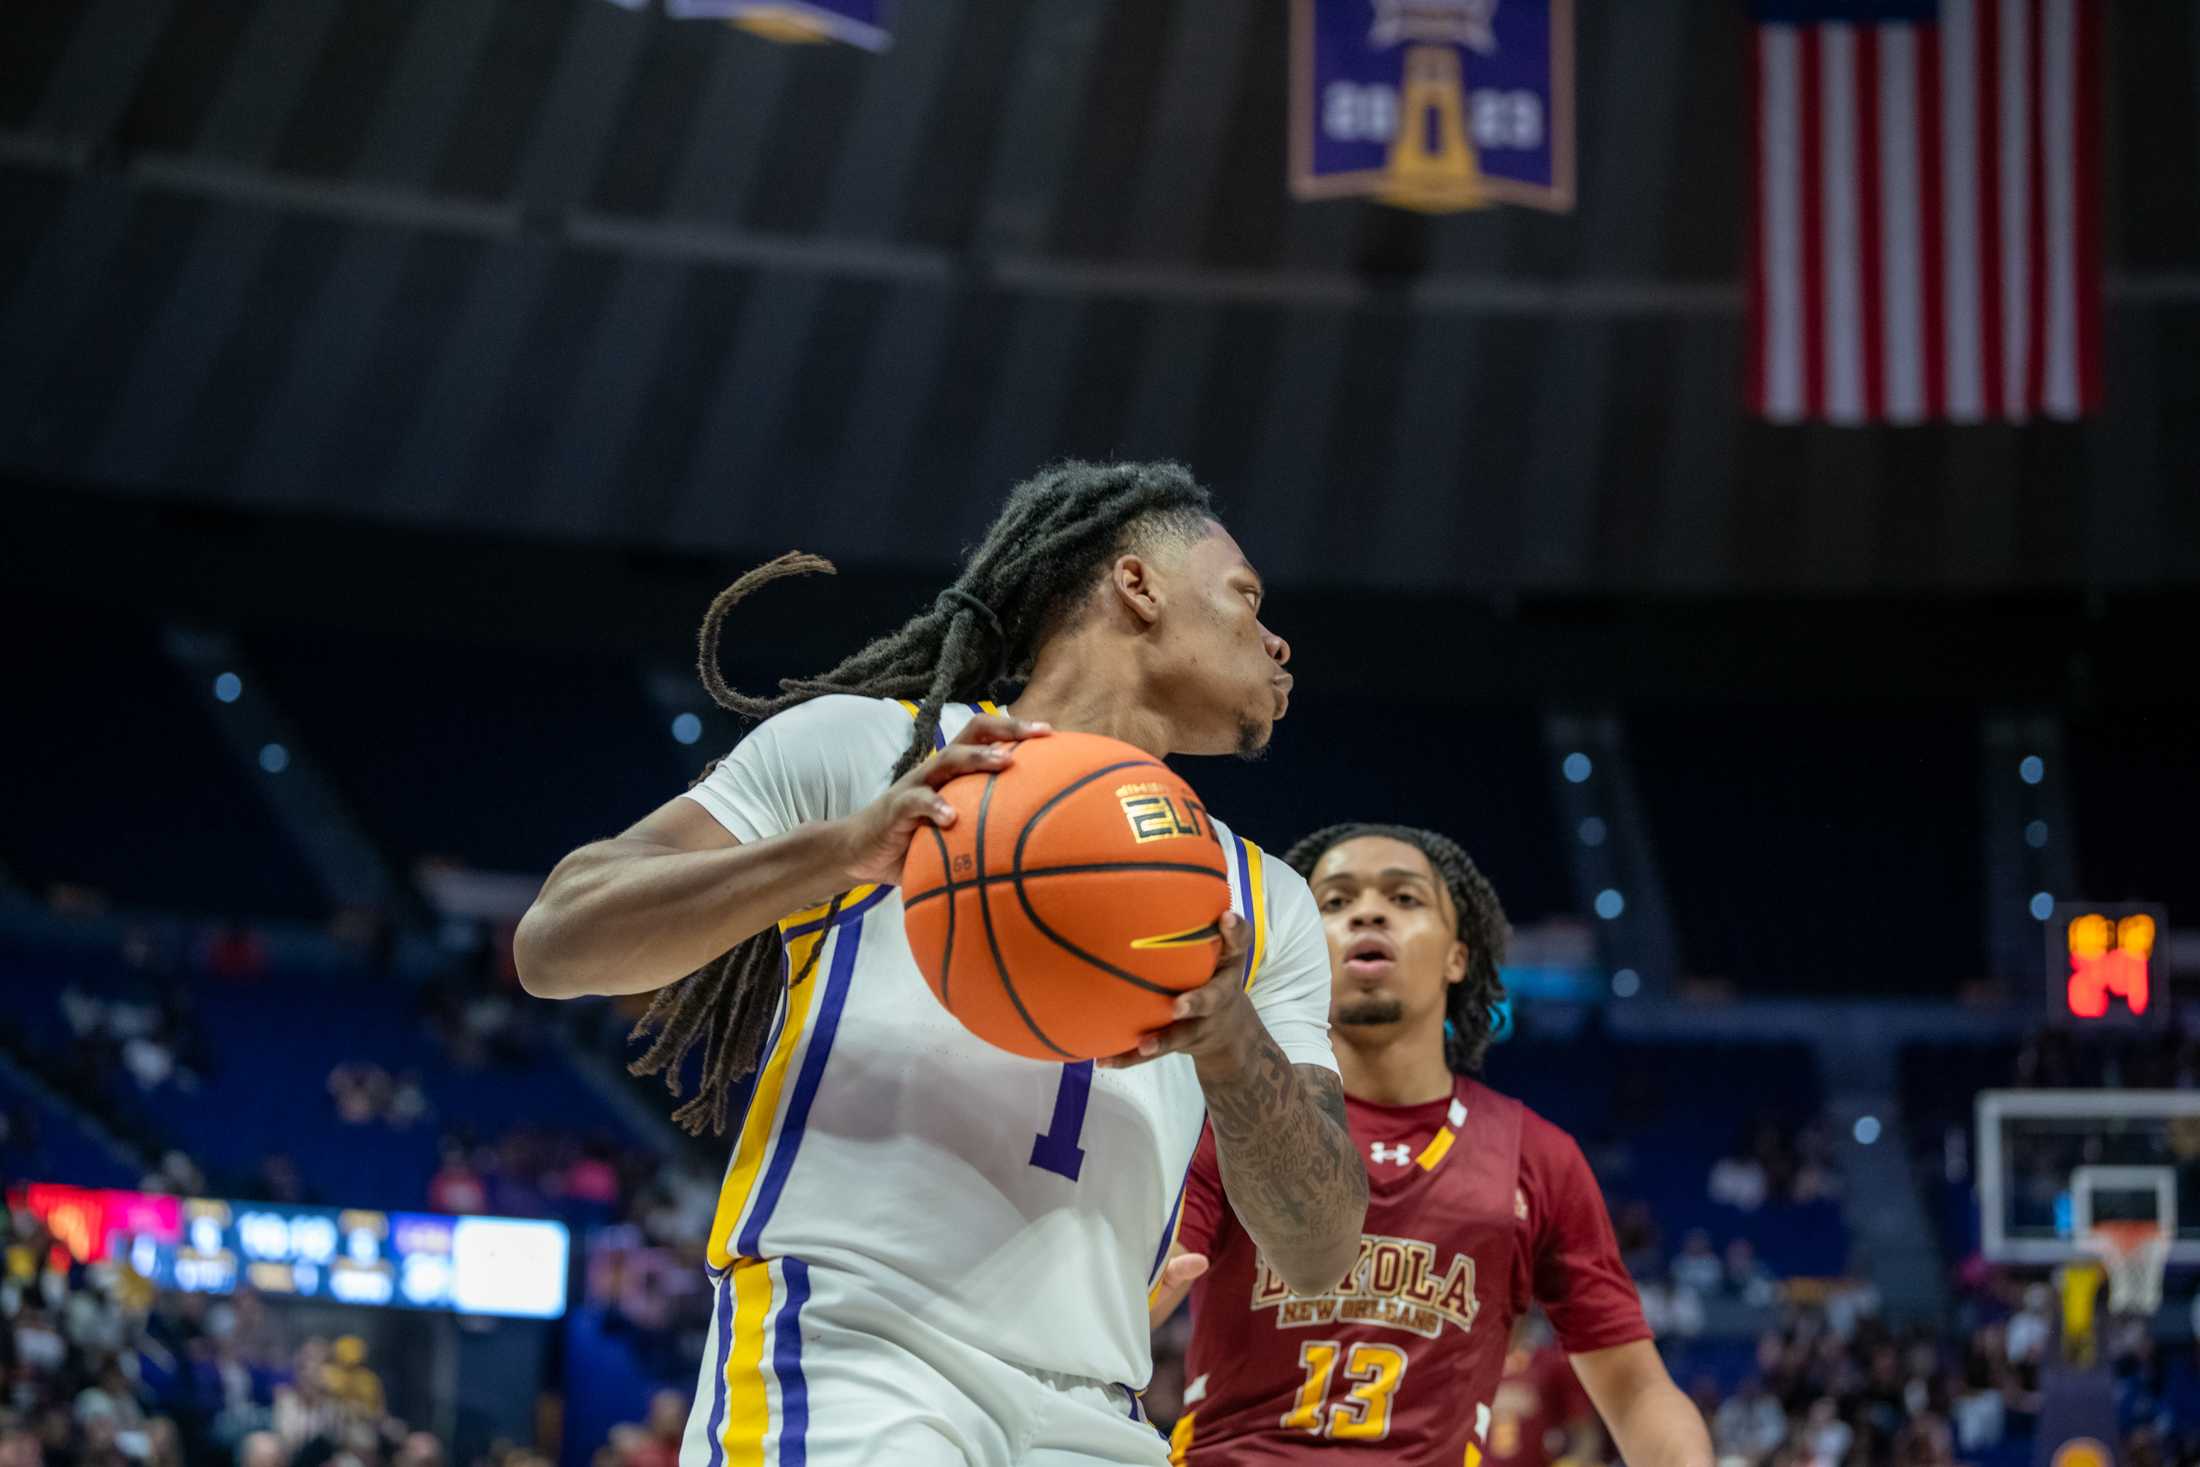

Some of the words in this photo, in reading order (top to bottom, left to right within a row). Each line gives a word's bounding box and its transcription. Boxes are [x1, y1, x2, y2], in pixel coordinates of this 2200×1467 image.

[1029, 1058, 1094, 1182] 1
[1279, 1299, 1337, 1326] NEW
[1338, 1298, 1443, 1338] ORLEANS
[1280, 1340, 1408, 1440] 13
